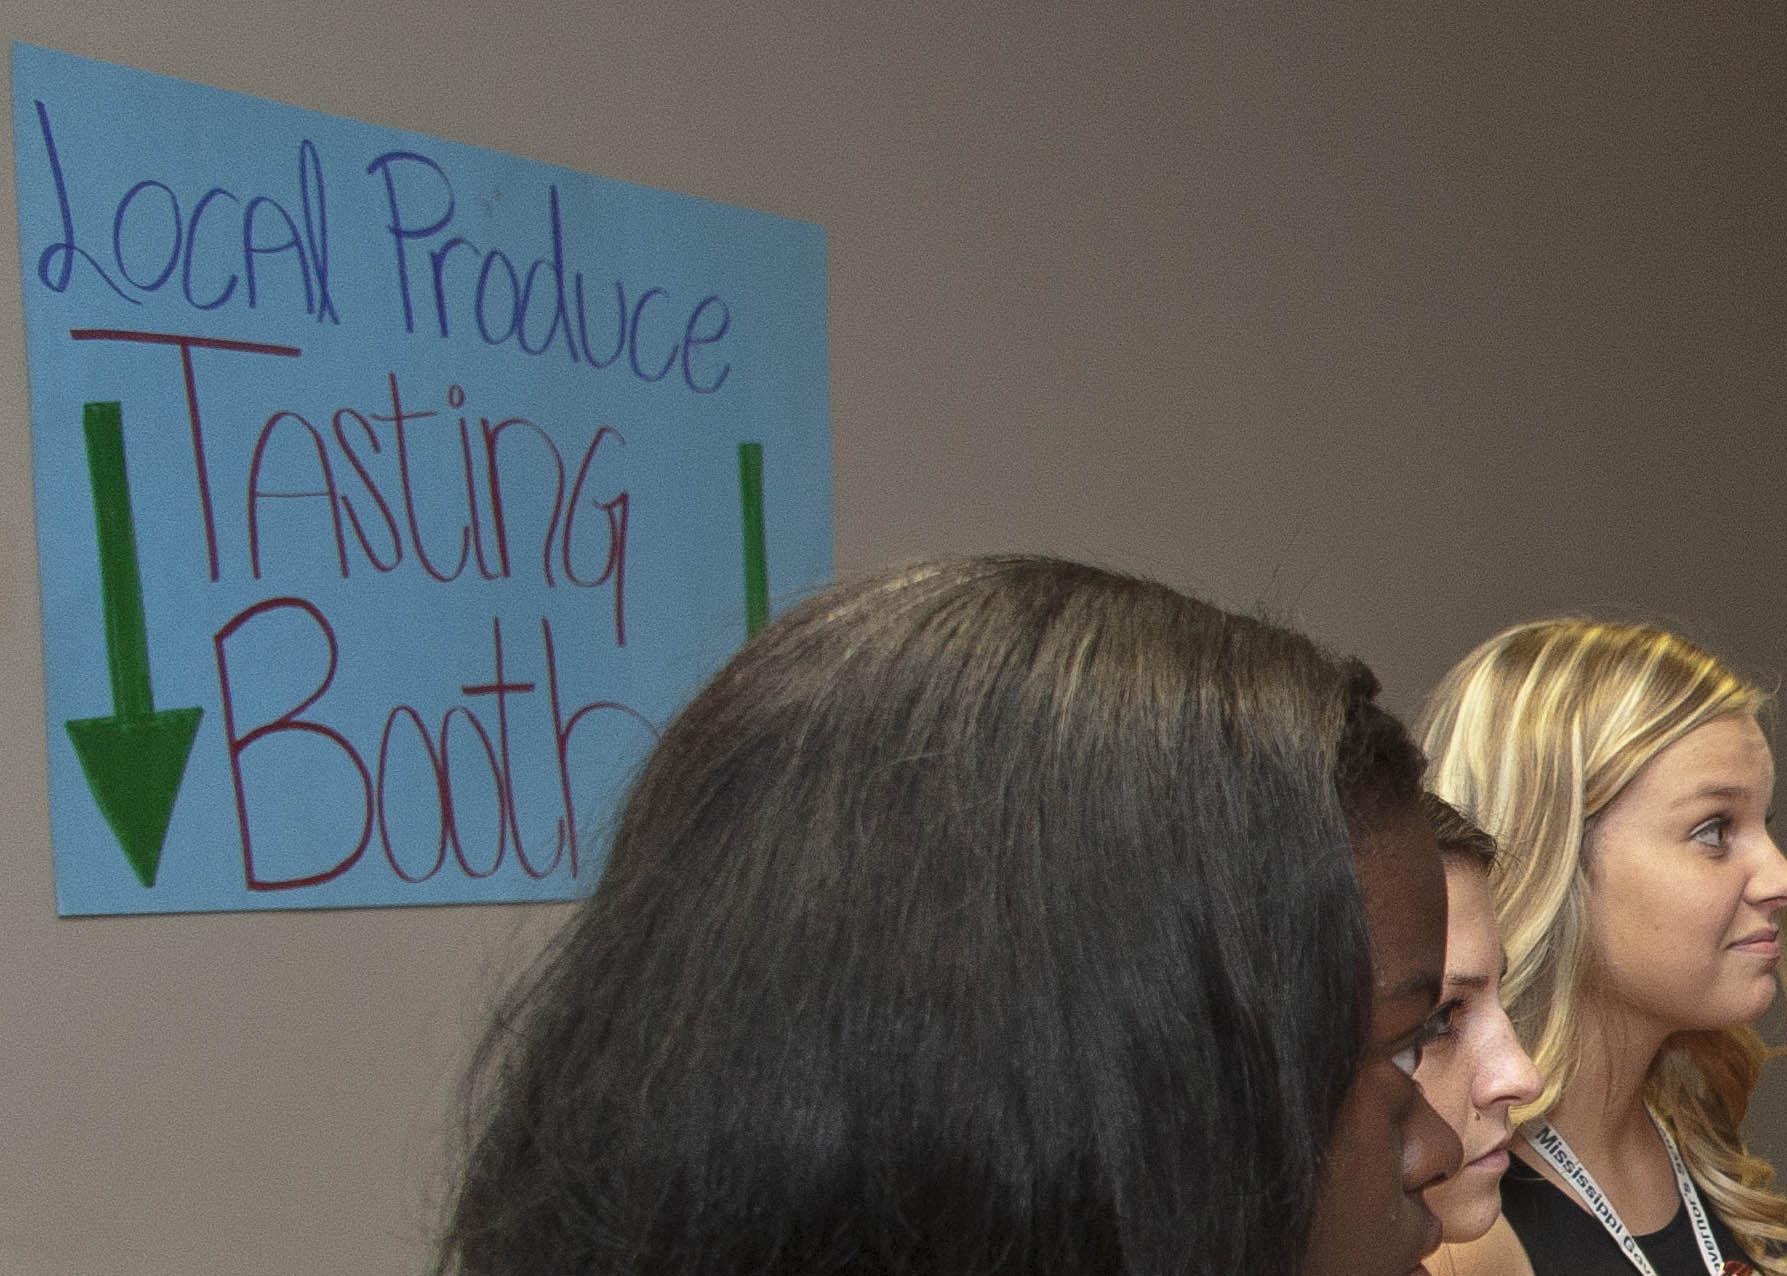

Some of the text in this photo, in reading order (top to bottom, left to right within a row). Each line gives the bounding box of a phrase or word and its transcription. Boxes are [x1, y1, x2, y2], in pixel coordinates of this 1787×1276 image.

[367, 151, 733, 395] Produce
[213, 596, 666, 892] Booth
[1535, 1126, 1623, 1234] Mississippi
